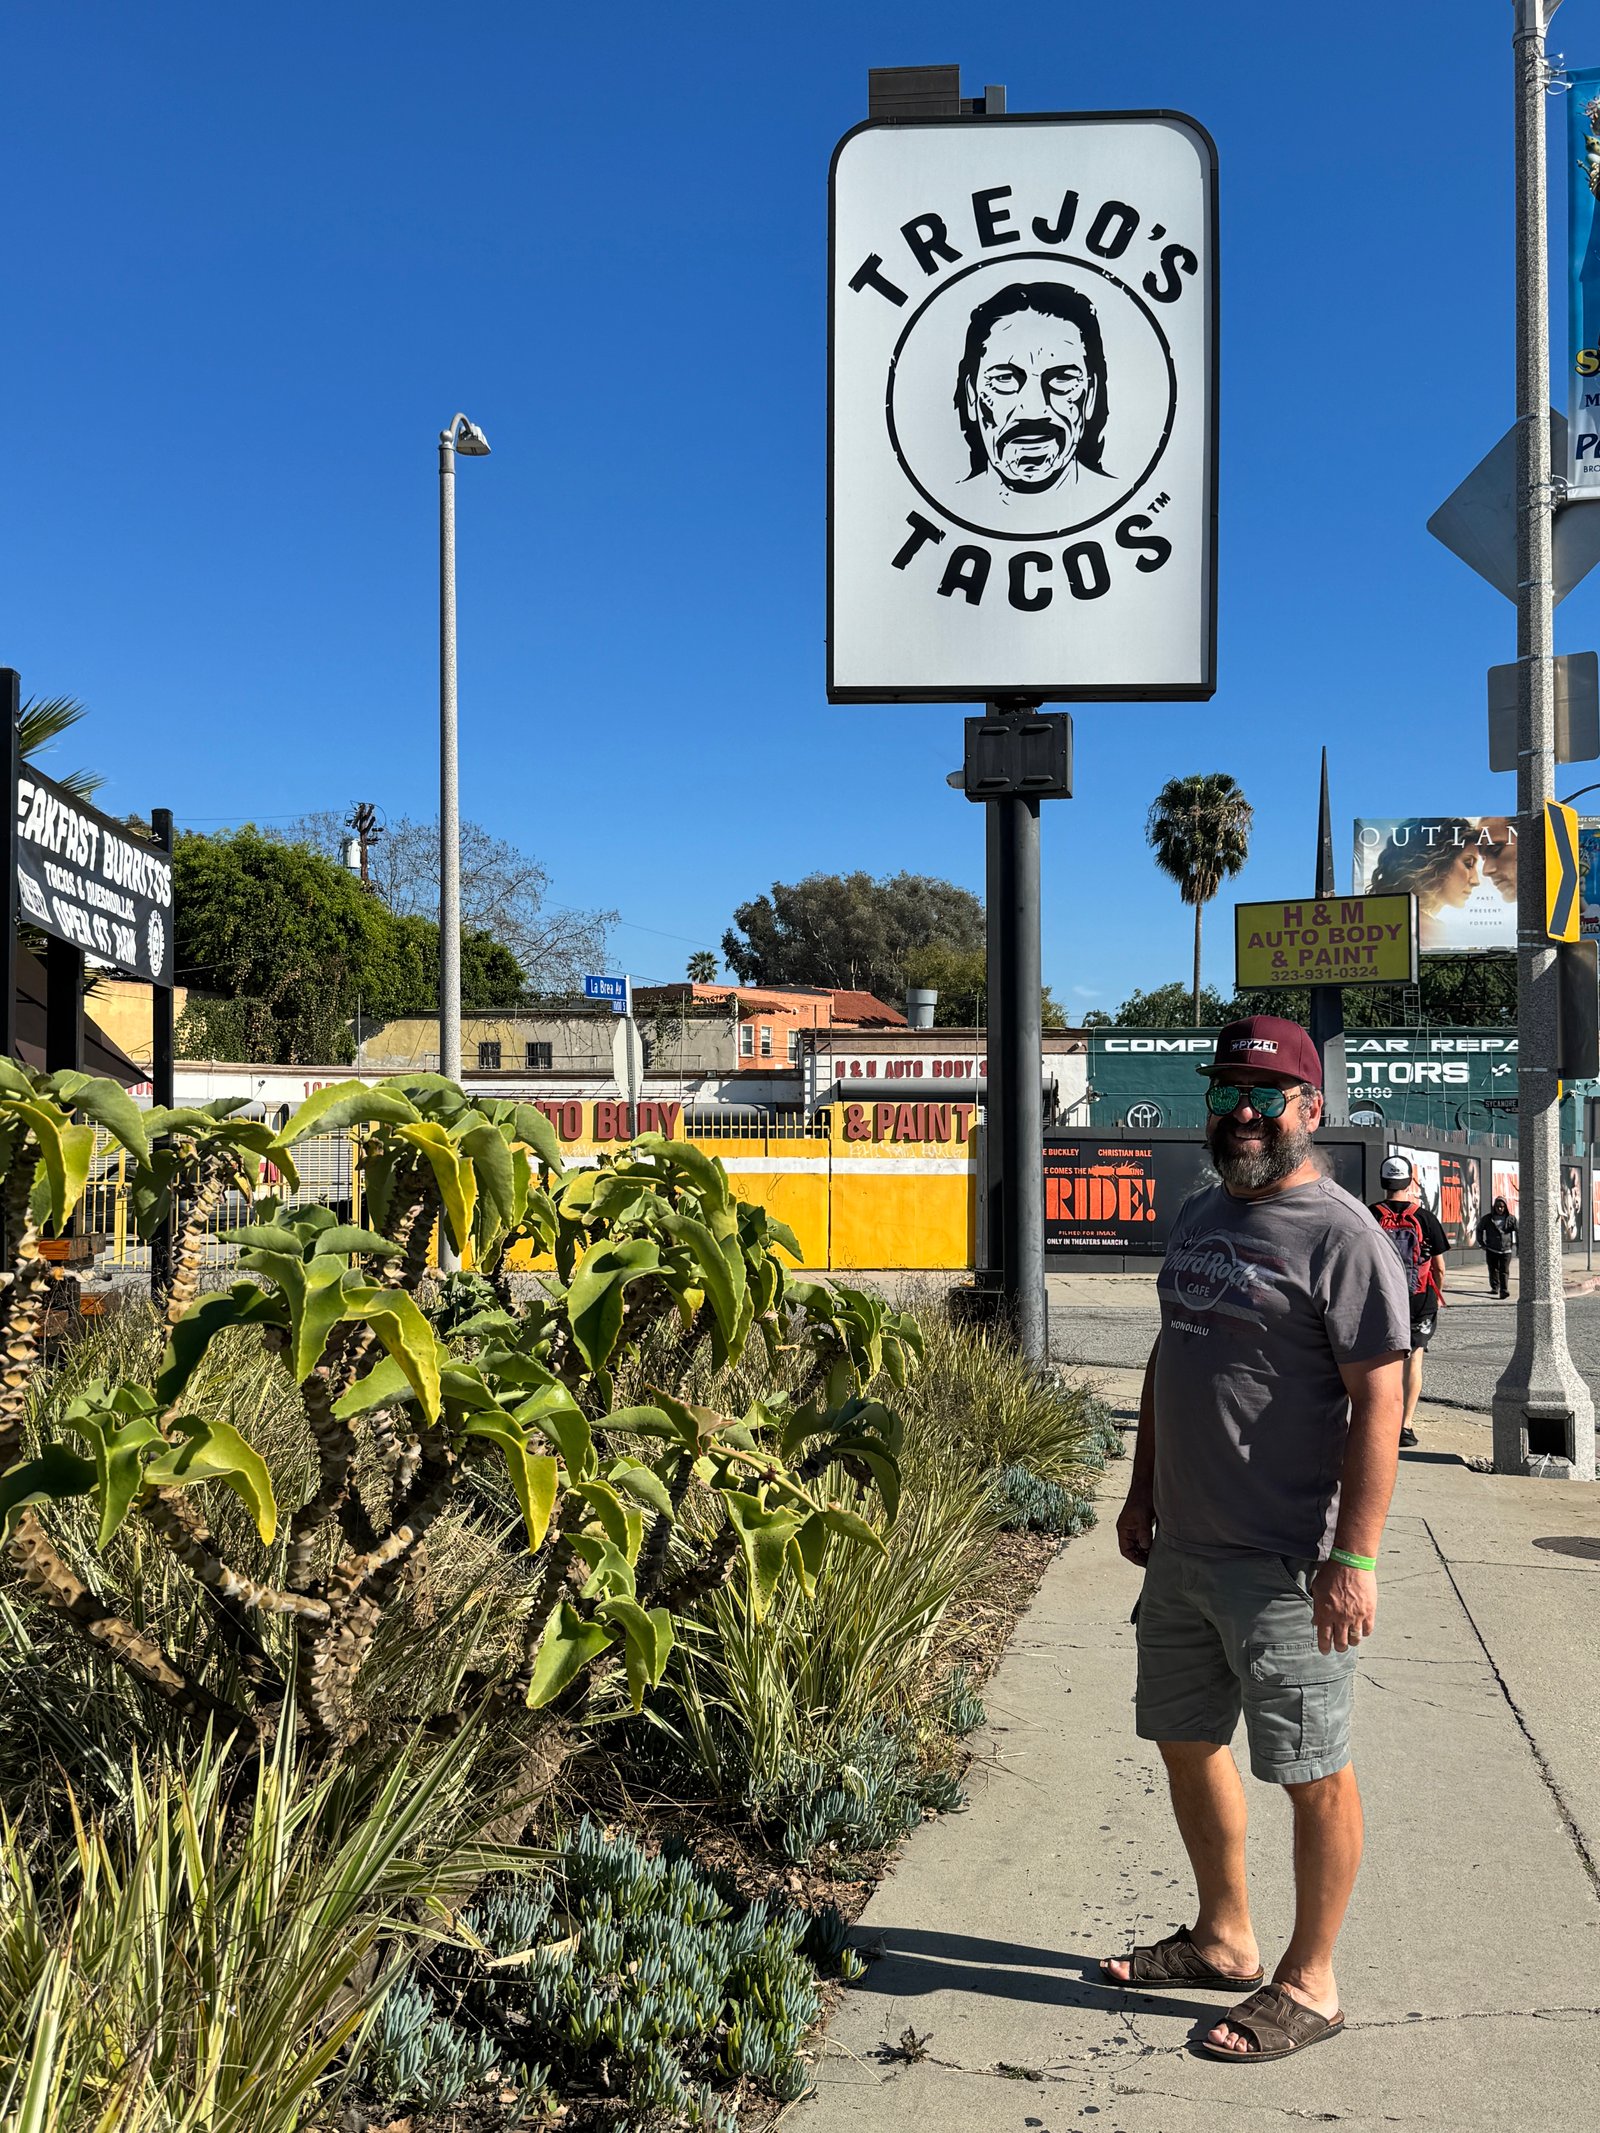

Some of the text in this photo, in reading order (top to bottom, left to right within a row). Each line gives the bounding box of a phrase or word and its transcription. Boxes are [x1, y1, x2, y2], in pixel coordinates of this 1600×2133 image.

[849, 184, 1199, 308] TREJO'S
[890, 510, 1173, 612] TACOS
[43, 861, 77, 897] TACOS
[103, 830, 172, 908] BURRITOS
[52, 896, 97, 948] OPEN
[93, 914, 112, 955] AT
[1283, 901, 1364, 928] H & M
[1247, 923, 1403, 949] AUTO BODY
[1271, 945, 1379, 968] & PAINT
[590, 978, 599, 994] La
[600, 979, 614, 995] Brea
[1271, 965, 1379, 982] 323-931-0324
[1239, 1039, 1277, 1053] PYZEL
[884, 1060, 924, 1079] AUTO
[931, 1060, 974, 1079] BODY
[843, 1103, 974, 1144] & PAINT
[1048, 1148, 1080, 1156] BUCKLEY
[1097, 1149, 1134, 1158] CHRISTIAN
[1135, 1149, 1153, 1158] BALE
[1049, 1167, 1073, 1175] COMES
[1046, 1177, 1156, 1222] RIDE!
[1166, 1248, 1258, 1291] Hard Rock
[1186, 1283, 1210, 1298] CAFE
[1170, 1320, 1210, 1337] HONOLULU
